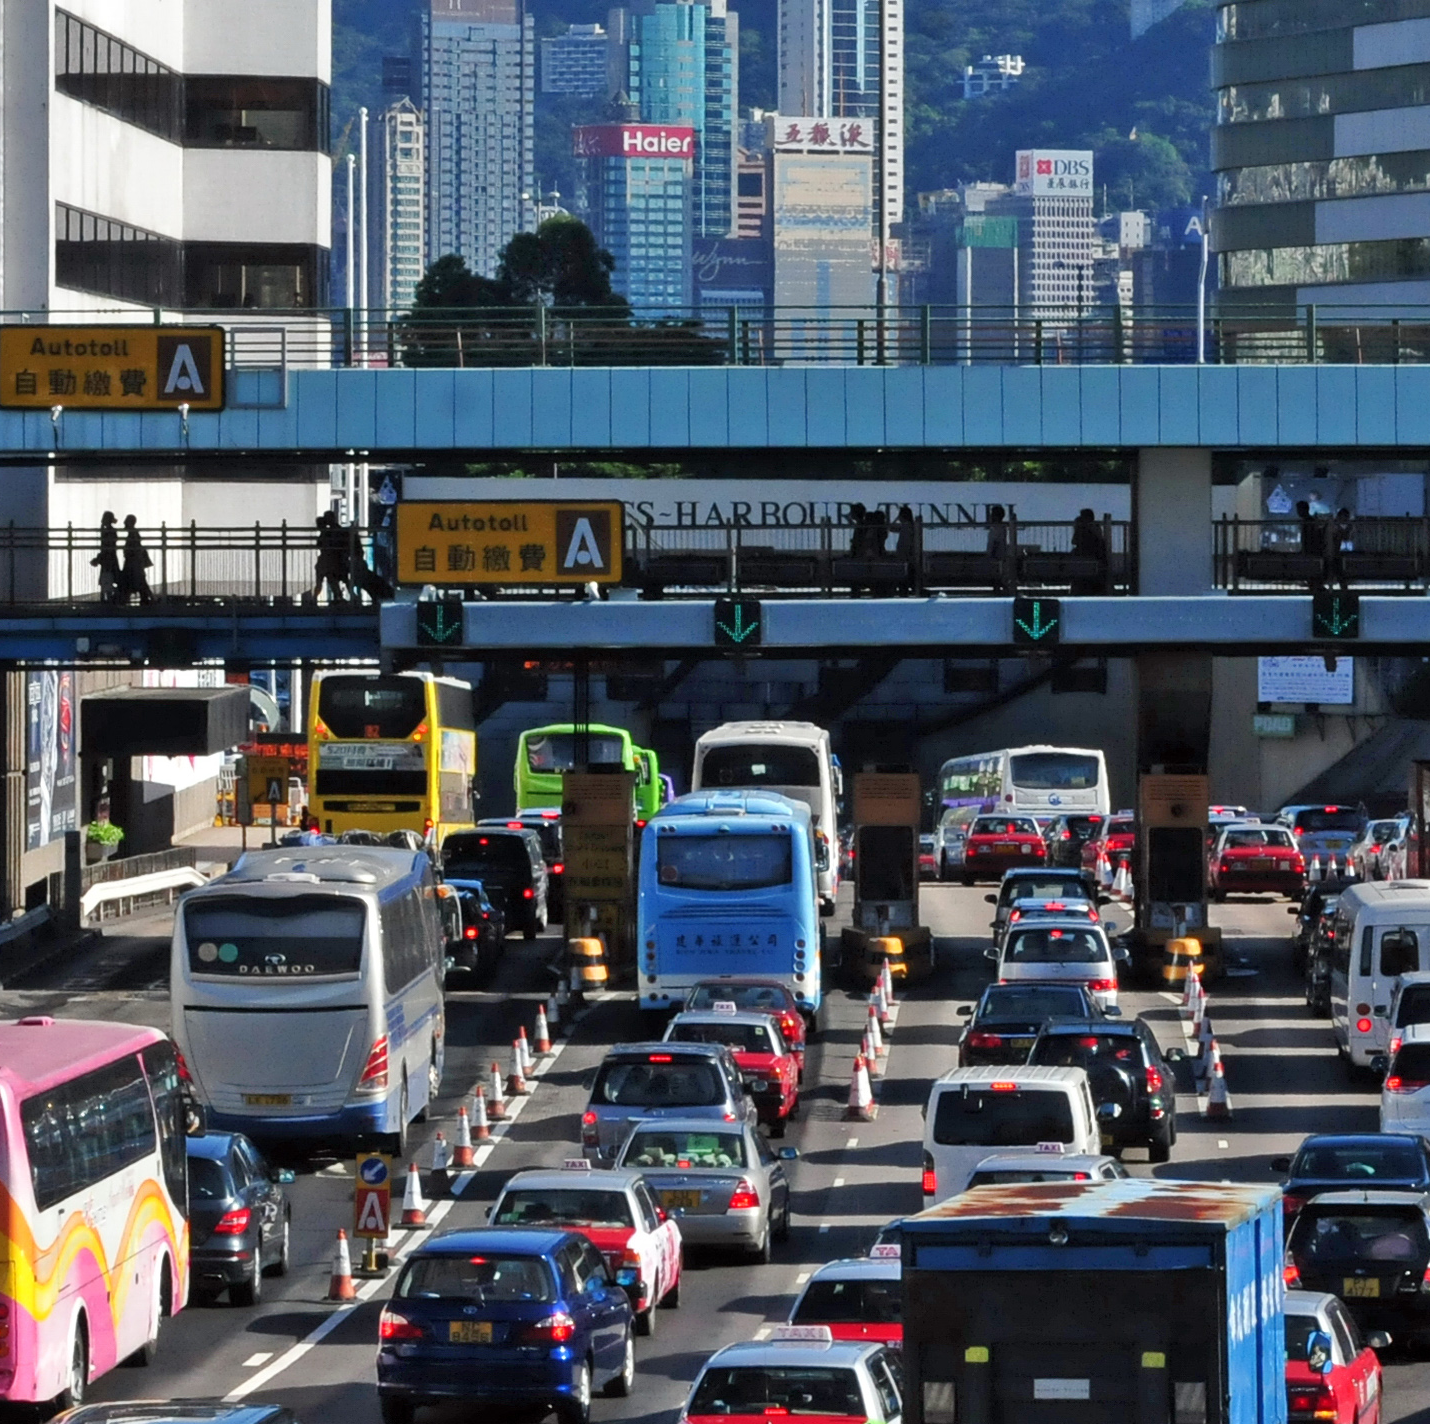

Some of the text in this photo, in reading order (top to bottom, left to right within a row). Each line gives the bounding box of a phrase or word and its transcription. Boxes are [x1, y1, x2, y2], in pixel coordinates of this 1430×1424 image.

[623, 131, 691, 153] Haier
[1054, 159, 1090, 176] DBS
[30, 337, 130, 357] Autotoll
[15, 369, 148, 397] 自動繳費
[428, 513, 528, 531] Autotoll
[414, 544, 547, 572] 自動繳費
[239, 964, 315, 974] DAEWOO
[1038, 1144, 1061, 1152] TAXI
[777, 1327, 825, 1339] TAXI
